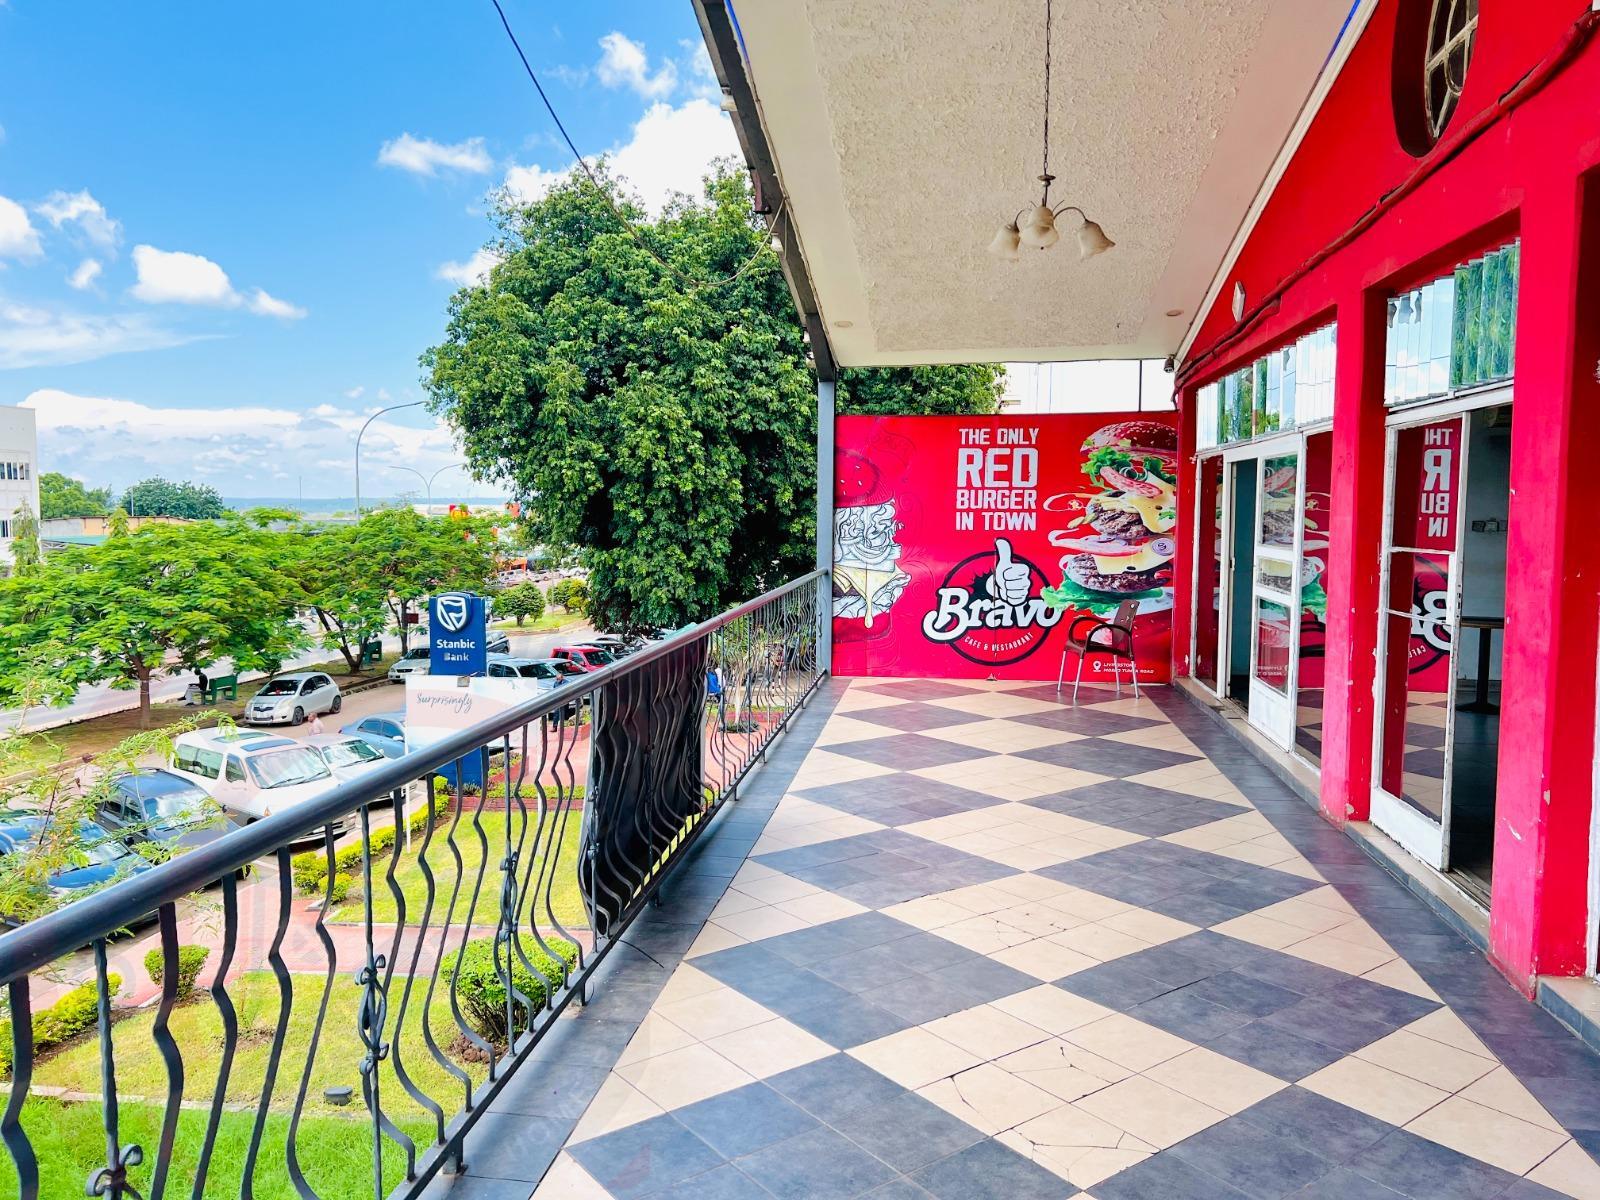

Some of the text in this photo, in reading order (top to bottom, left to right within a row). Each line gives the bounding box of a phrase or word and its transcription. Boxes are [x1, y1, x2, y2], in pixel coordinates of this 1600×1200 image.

[959, 428, 1039, 445] THE ONLY
[957, 447, 1039, 488] RED
[956, 489, 1037, 510] BURGER
[955, 511, 1037, 531] IN TOWN
[922, 587, 1062, 642] Bravo
[436, 638, 476, 650] Stanbic
[964, 635, 982, 649] CAFE
[443, 652, 470, 661] Bank
[416, 691, 473, 714] Surprisingly
